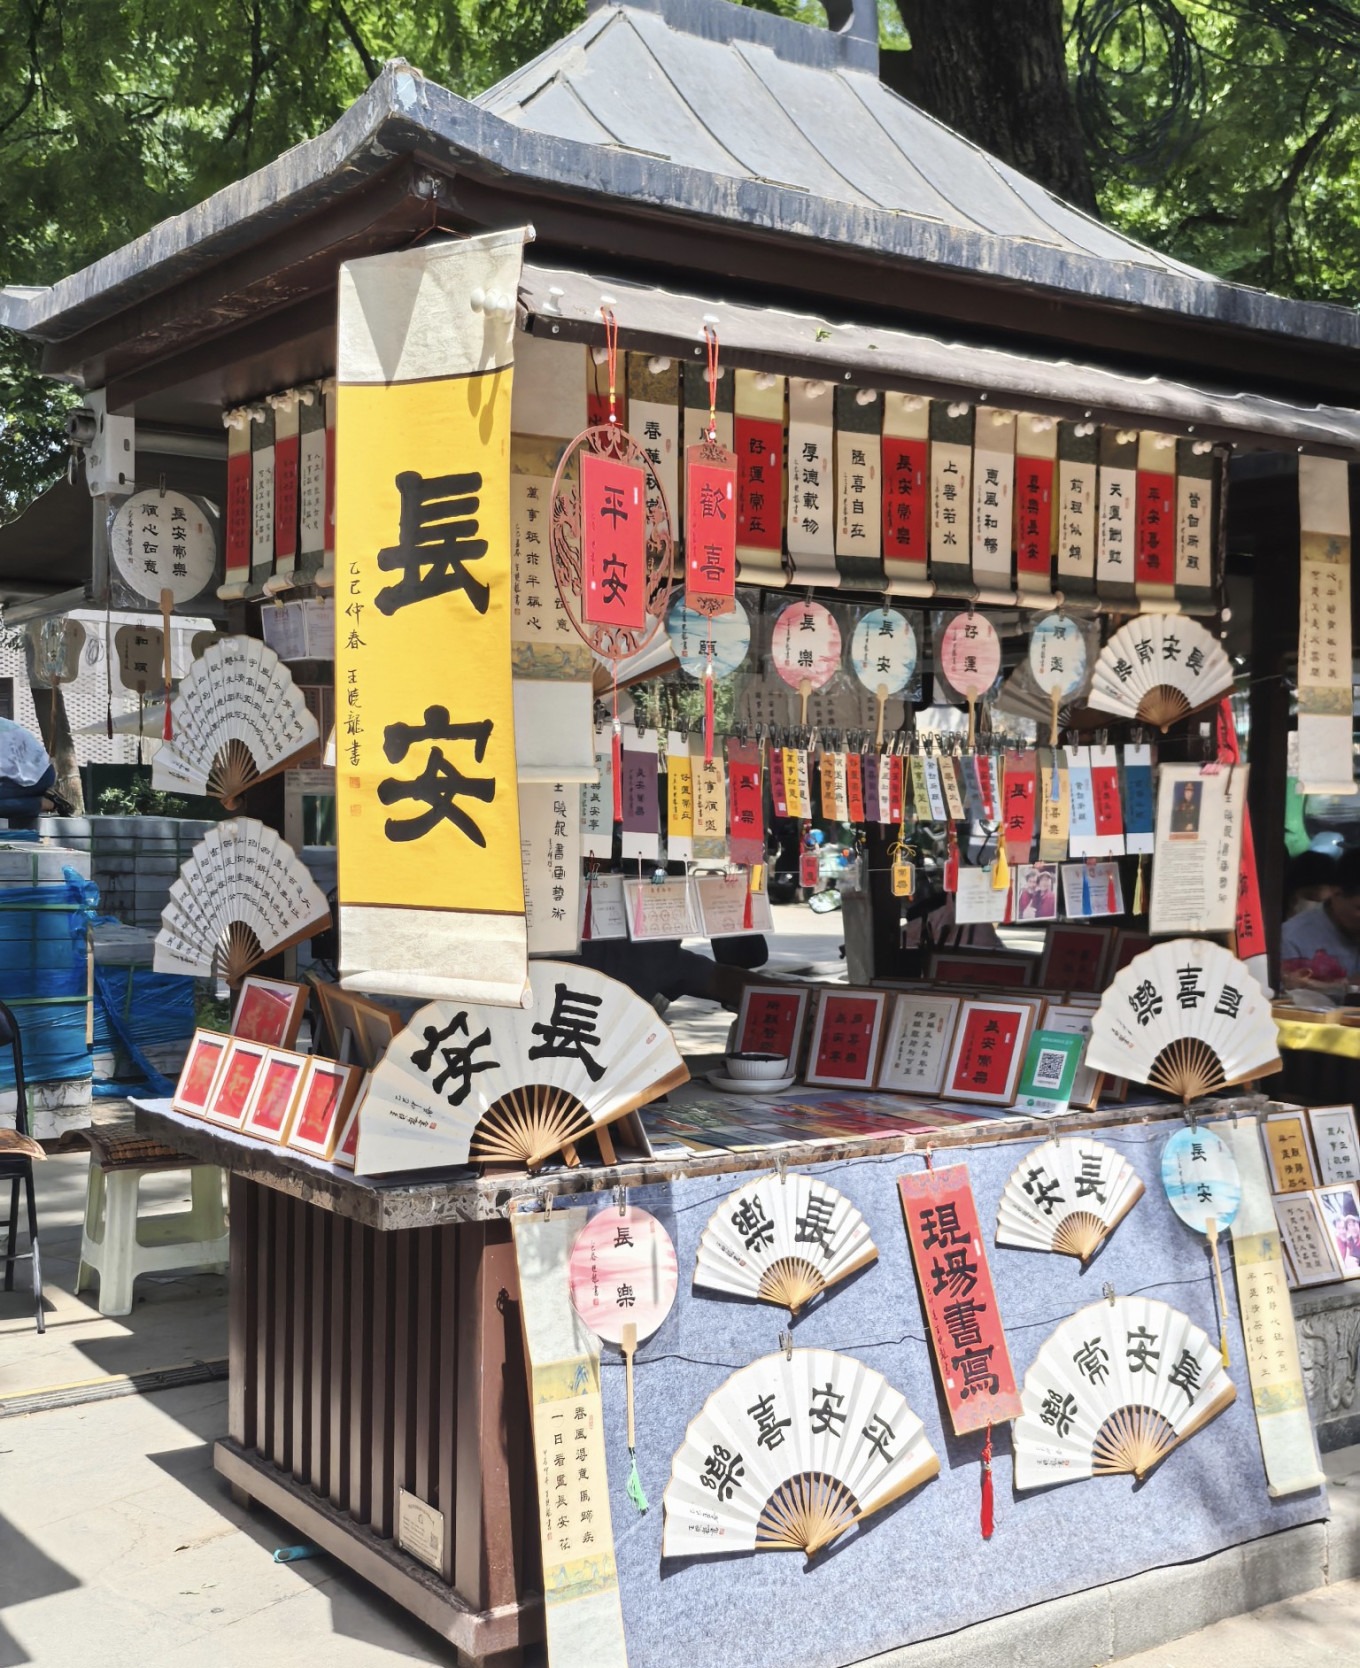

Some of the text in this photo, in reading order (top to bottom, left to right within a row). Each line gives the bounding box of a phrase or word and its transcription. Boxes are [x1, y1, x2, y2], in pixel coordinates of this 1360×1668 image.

[749, 437, 766, 533] 好運常在
[801, 442, 819, 535] 厚德載物
[850, 449, 866, 538] 隨喜自在
[942, 459, 959, 545] 上善若水
[600, 485, 628, 607] 平安
[700, 483, 728, 583] 歡喜
[374, 471, 495, 848] 長安
[798, 613, 815, 667] 長樂
[876, 620, 894, 673] 長安
[964, 624, 978, 672] 好運
[740, 776, 755, 824] 長樂
[1010, 783, 1028, 831] 長安
[411, 983, 607, 1106] 長安
[1022, 1150, 1107, 1215] 長安
[1191, 1143, 1213, 1203] 長安
[612, 1226, 638, 1309] 長樂
[731, 1190, 836, 1260] 長樂
[920, 1202, 1000, 1399] 現場書寫
[700, 1382, 897, 1502] 平安喜樂
